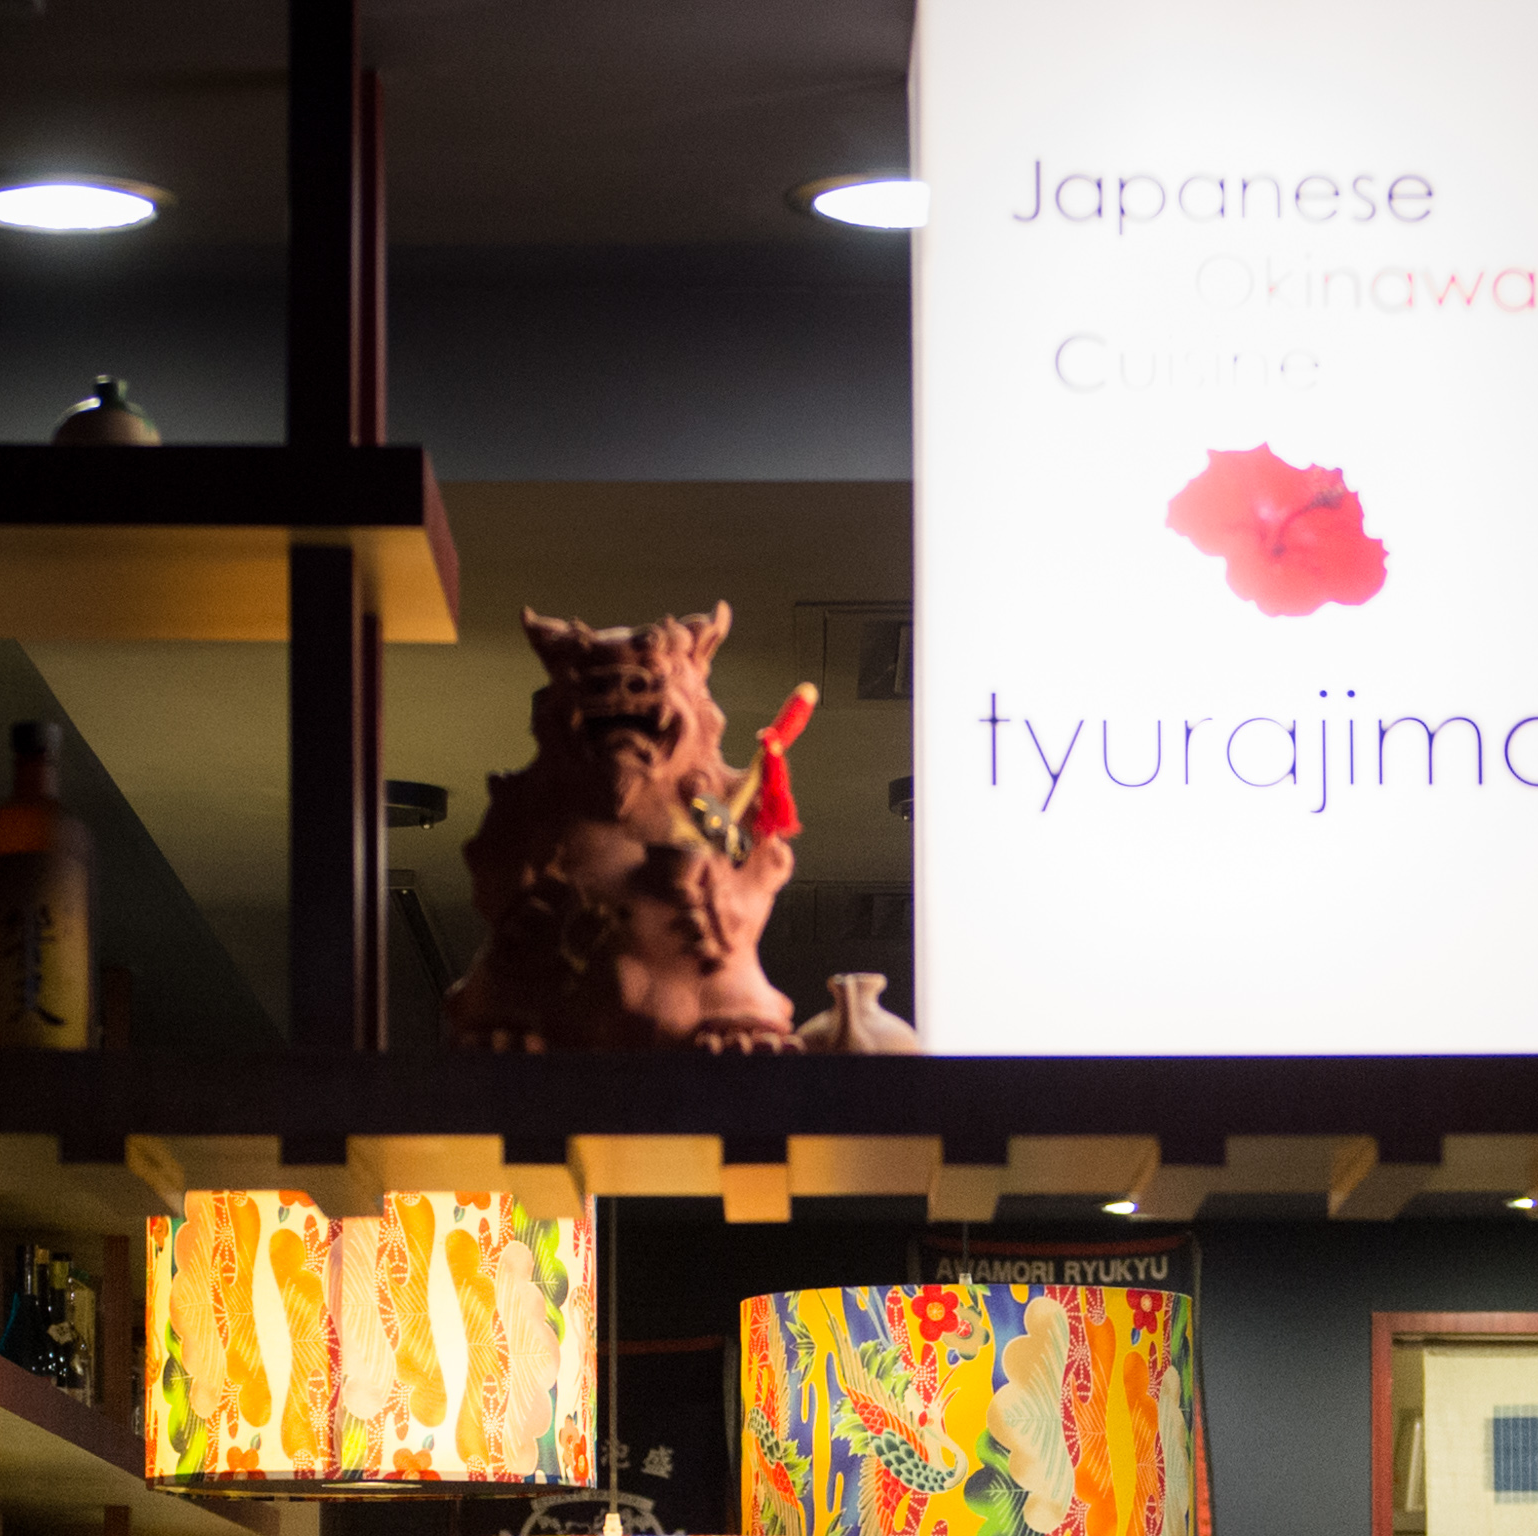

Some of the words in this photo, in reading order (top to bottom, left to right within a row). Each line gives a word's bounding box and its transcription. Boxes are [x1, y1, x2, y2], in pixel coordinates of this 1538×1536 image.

[1012, 159, 1434, 235] Japanese
[1194, 251, 1538, 313] Okinawa
[936, 1259, 1055, 1284] AWAMORI
[1063, 1256, 1169, 1283] RYUKYU
